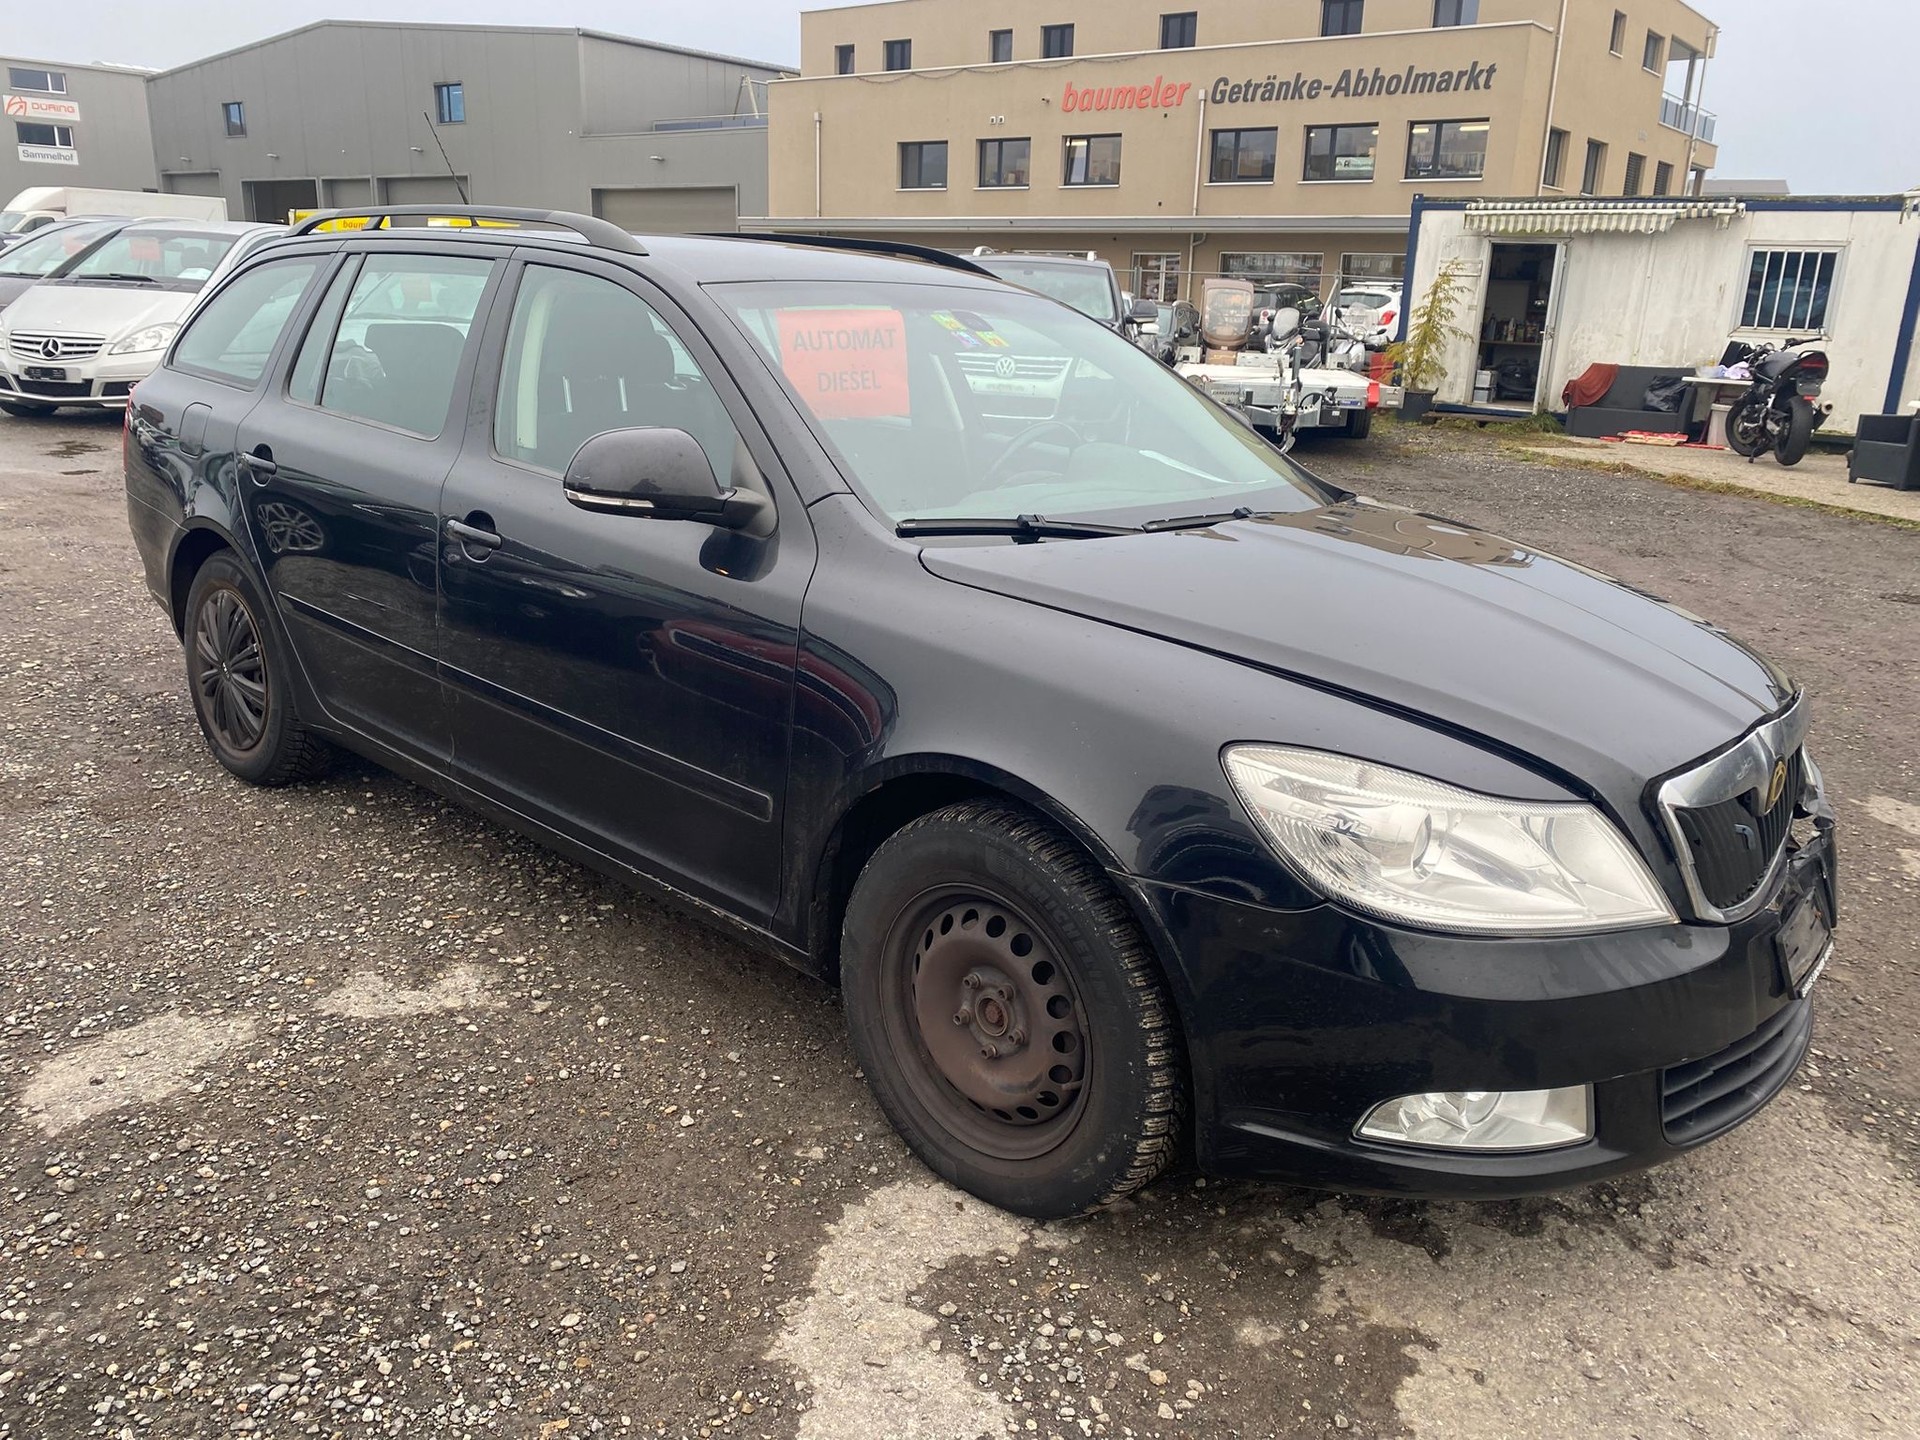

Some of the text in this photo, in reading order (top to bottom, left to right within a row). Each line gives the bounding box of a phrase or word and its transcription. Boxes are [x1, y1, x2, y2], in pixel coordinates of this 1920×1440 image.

[1062, 61, 1497, 112] baumeler Getränke-Abholmarkt
[22, 149, 73, 161] Sammelhof
[793, 328, 896, 352] AUTOMAT
[816, 370, 882, 392] DIESEL
